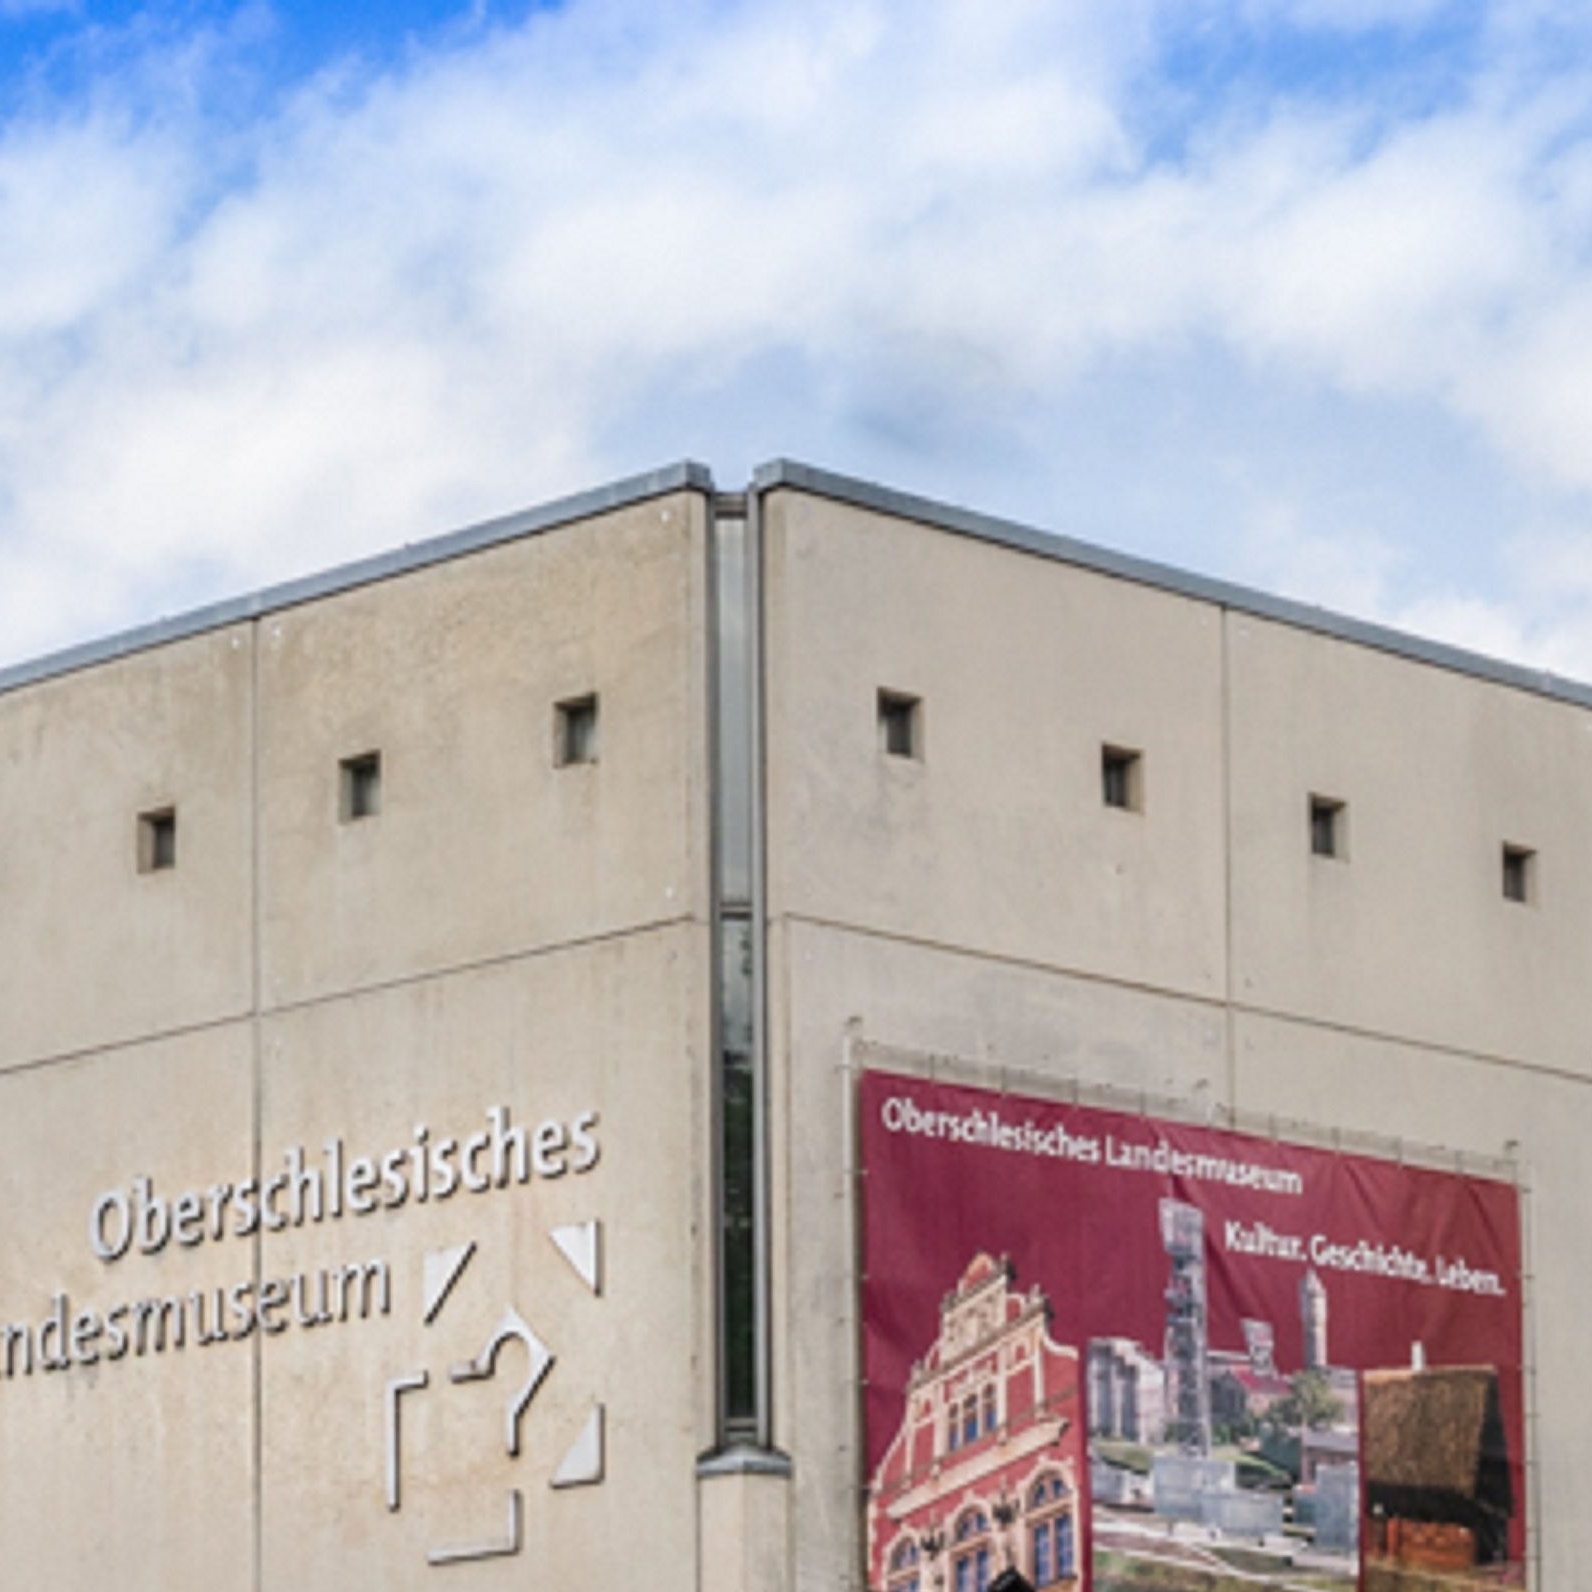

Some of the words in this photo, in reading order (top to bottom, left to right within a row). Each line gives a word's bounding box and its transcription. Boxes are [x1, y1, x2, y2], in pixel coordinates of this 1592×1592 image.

[89, 1105, 601, 1262] Oberschlesisches
[881, 1096, 1100, 1163] Oberschlesisches
[1106, 1135, 1303, 1194] Landesmuseum
[1224, 1219, 1307, 1261] Kultur.
[1311, 1234, 1434, 1284] Geschichte.
[1436, 1255, 1506, 1296] Leben.
